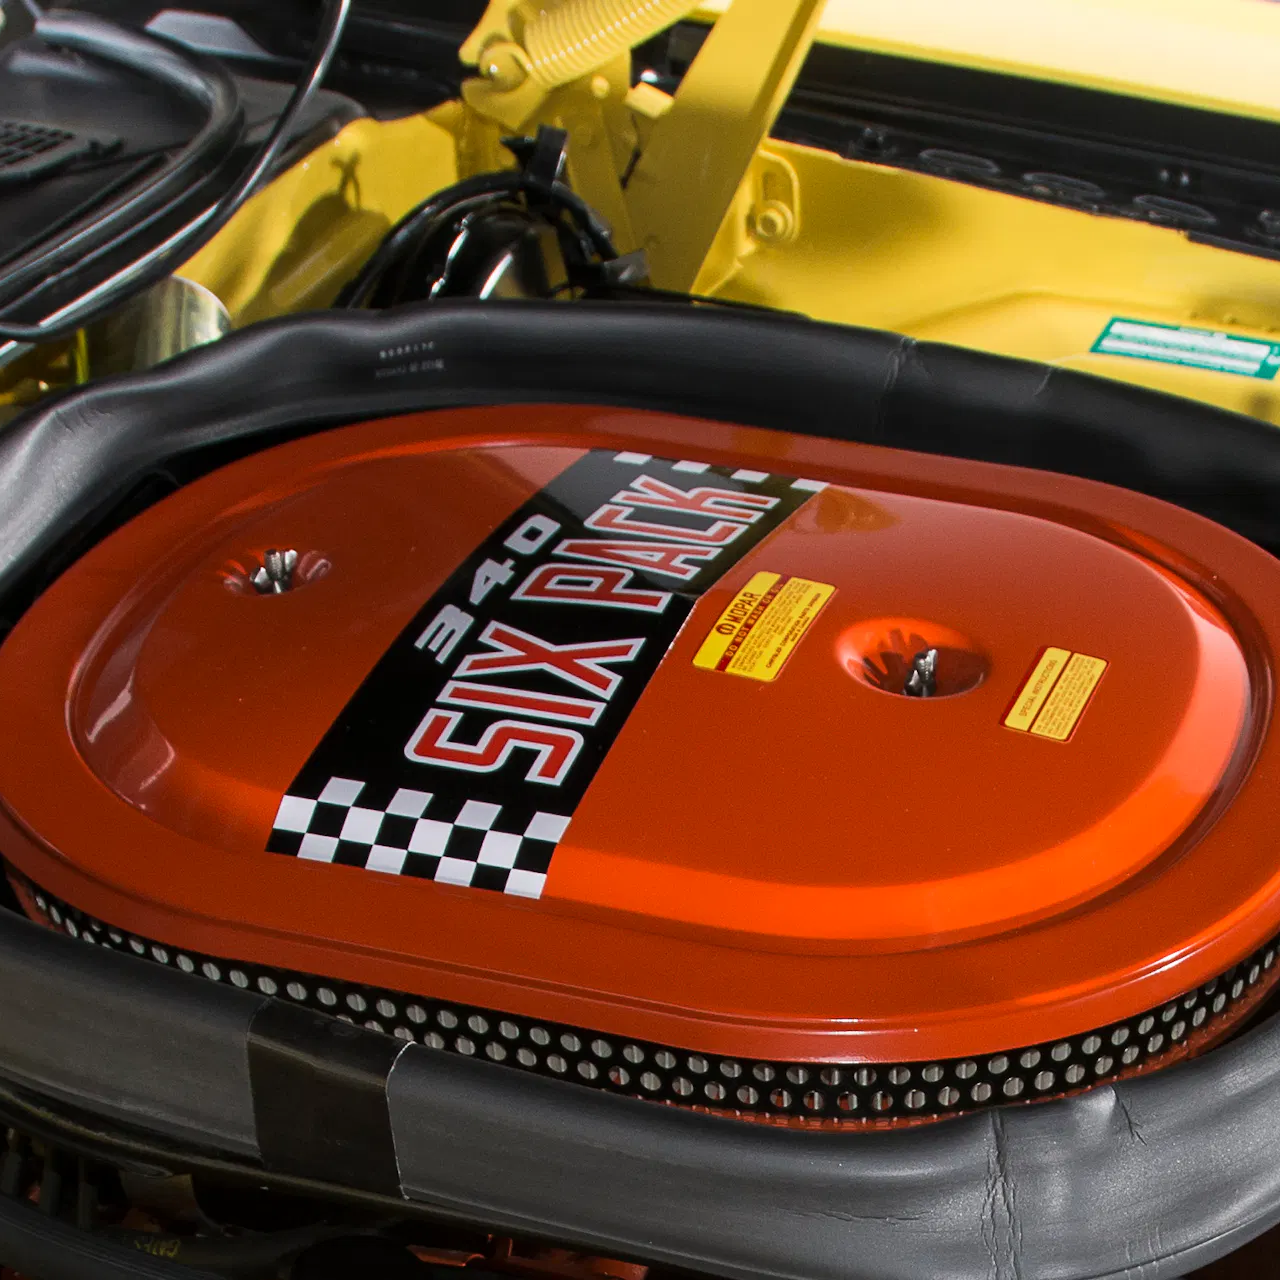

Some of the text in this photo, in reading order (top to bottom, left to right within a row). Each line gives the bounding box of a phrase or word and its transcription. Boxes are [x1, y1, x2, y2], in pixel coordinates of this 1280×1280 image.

[403, 472, 782, 787] SIX PACK
[413, 513, 562, 665] 340
[729, 592, 761, 624] MOPAR
[727, 644, 738, 656] DO
